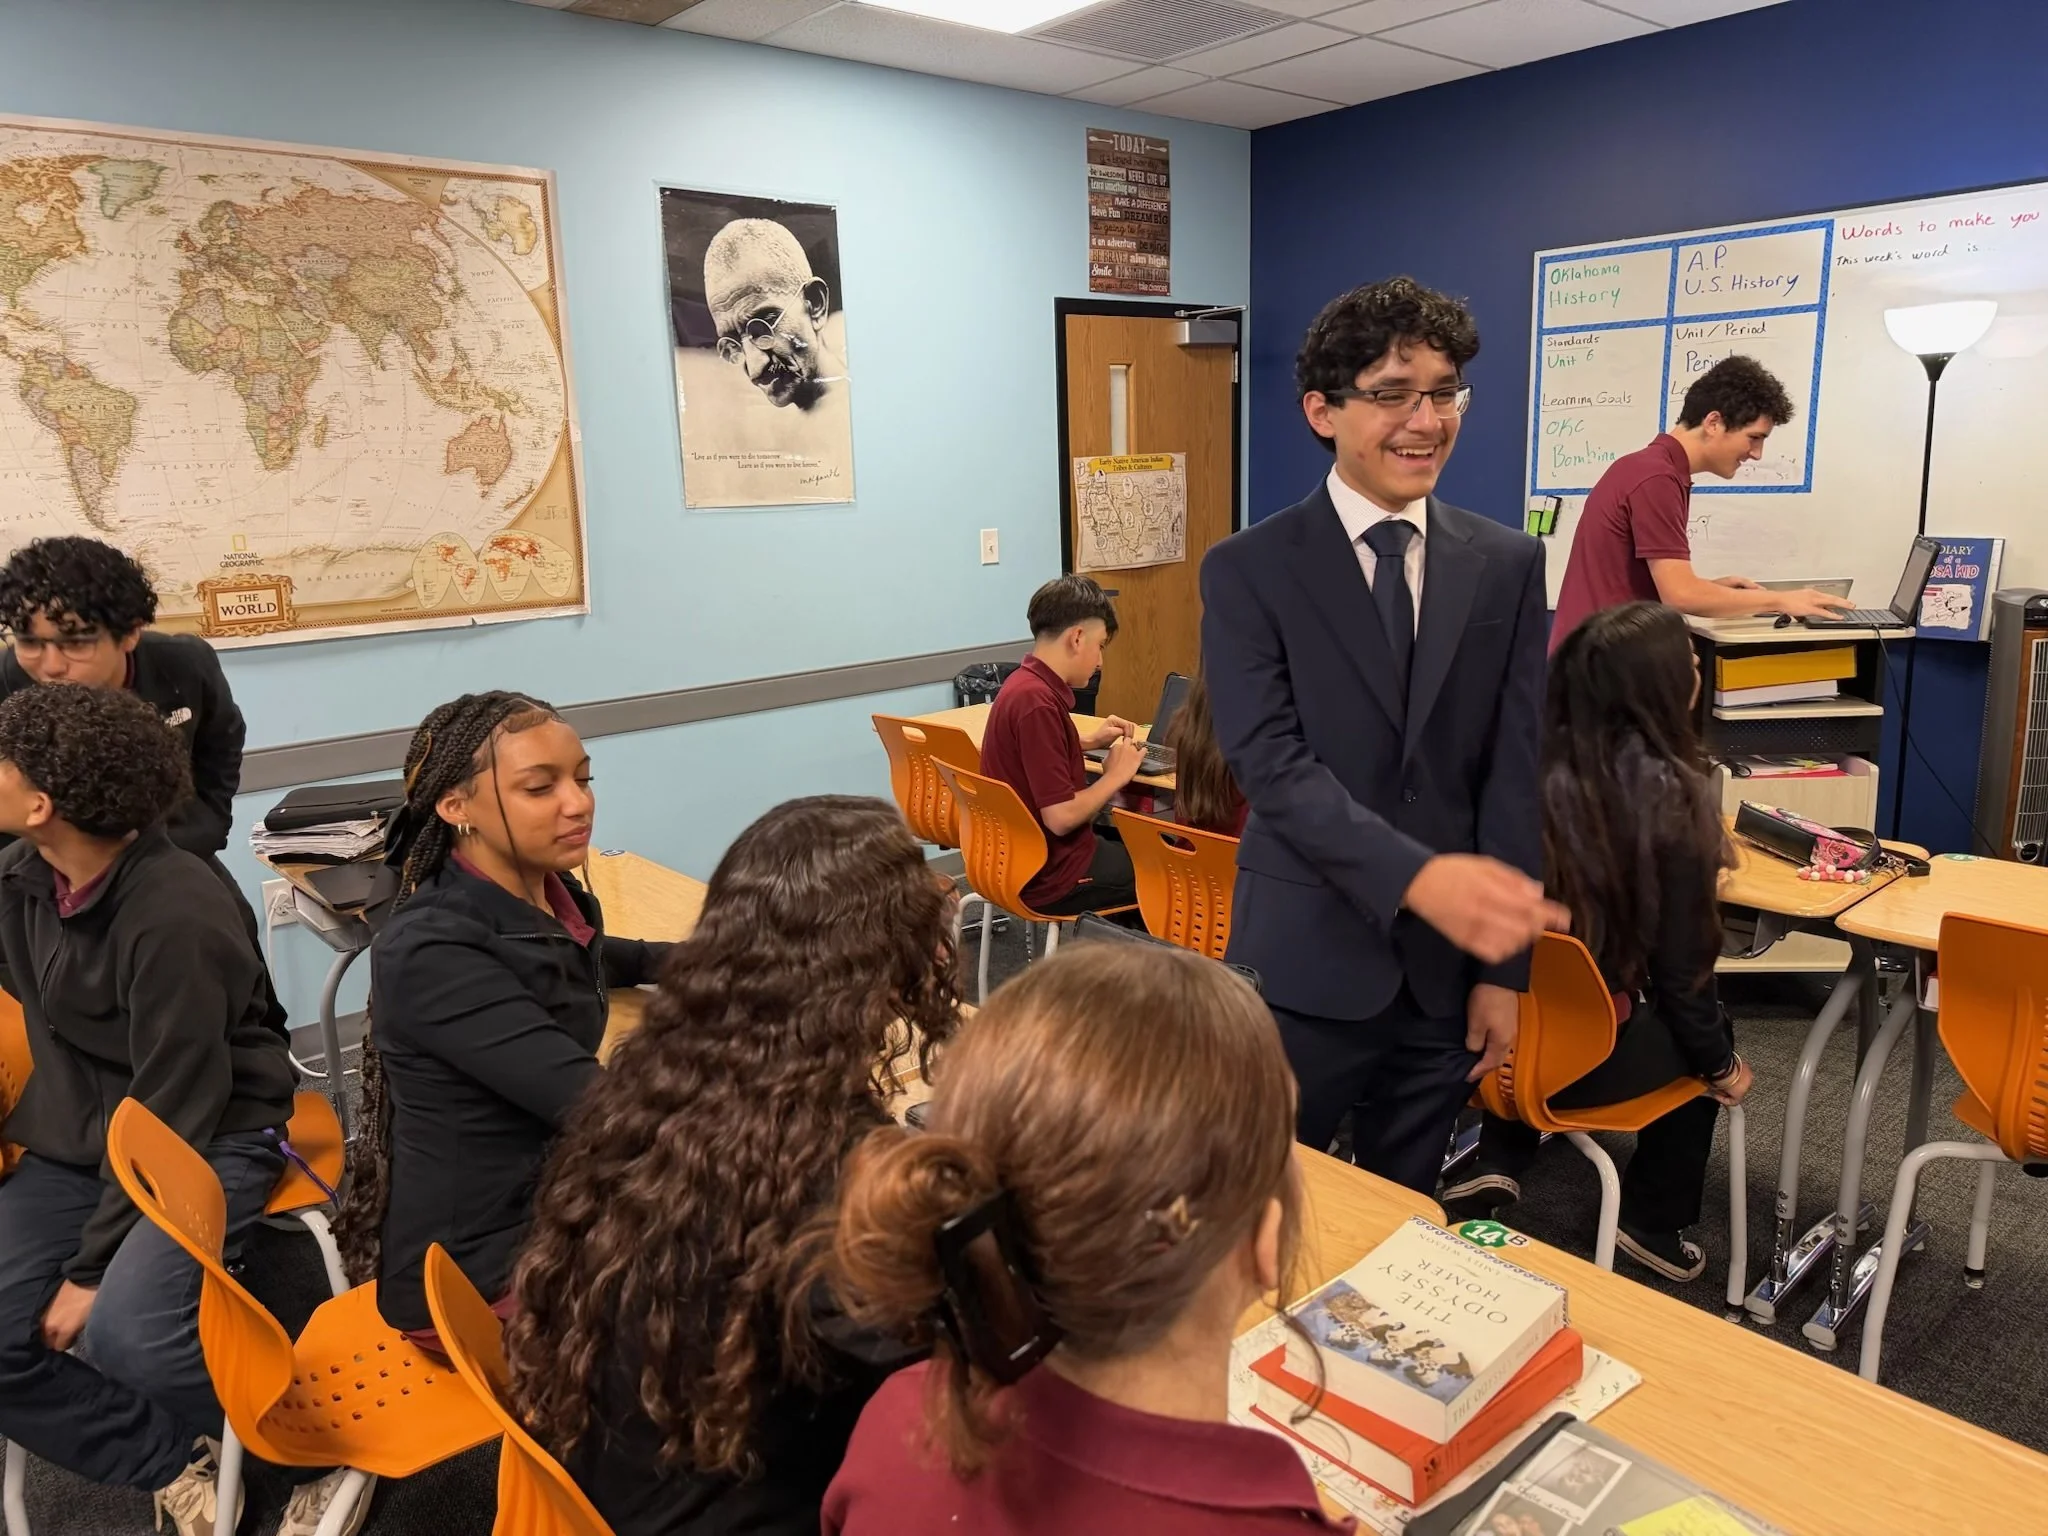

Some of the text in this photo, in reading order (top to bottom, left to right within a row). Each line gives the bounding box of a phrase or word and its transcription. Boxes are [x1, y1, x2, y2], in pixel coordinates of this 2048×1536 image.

[1113, 134, 1145, 154] TODAY
[1092, 206, 1120, 218] Have Fun
[1137, 200, 1167, 211] DIFFERENCE
[1842, 212, 2040, 240] Words to make you
[1108, 238, 1136, 248] adventure
[1130, 254, 1167, 267] aim high
[1687, 244, 1727, 272] A.P.
[1836, 256, 1858, 266] This
[1864, 251, 1902, 264] week's
[1912, 244, 1948, 260] word
[1092, 264, 1112, 276] Smile
[1550, 265, 1620, 285] Oklahoma
[1685, 274, 1799, 297] U.S. History
[1550, 288, 1620, 308] History
[1726, 321, 1766, 336] Period
[1547, 334, 1600, 347] Standards
[1548, 349, 1594, 368] Unit 6
[1542, 391, 1632, 407] Learning Goals
[1546, 418, 1585, 437] OKC
[224, 552, 259, 560] NATIONAL
[1939, 545, 1975, 555] DIARY
[220, 559, 264, 568] GEOGRAPHIC
[1955, 564, 1980, 579] KID
[236, 594, 259, 602] THE
[220, 603, 276, 616] WORLD
[1465, 1225, 1528, 1246] 14 B
[1417, 1258, 1502, 1302] HOMER
[1378, 1263, 1508, 1324] ODYSSEY
[1395, 1291, 1453, 1325] THE
